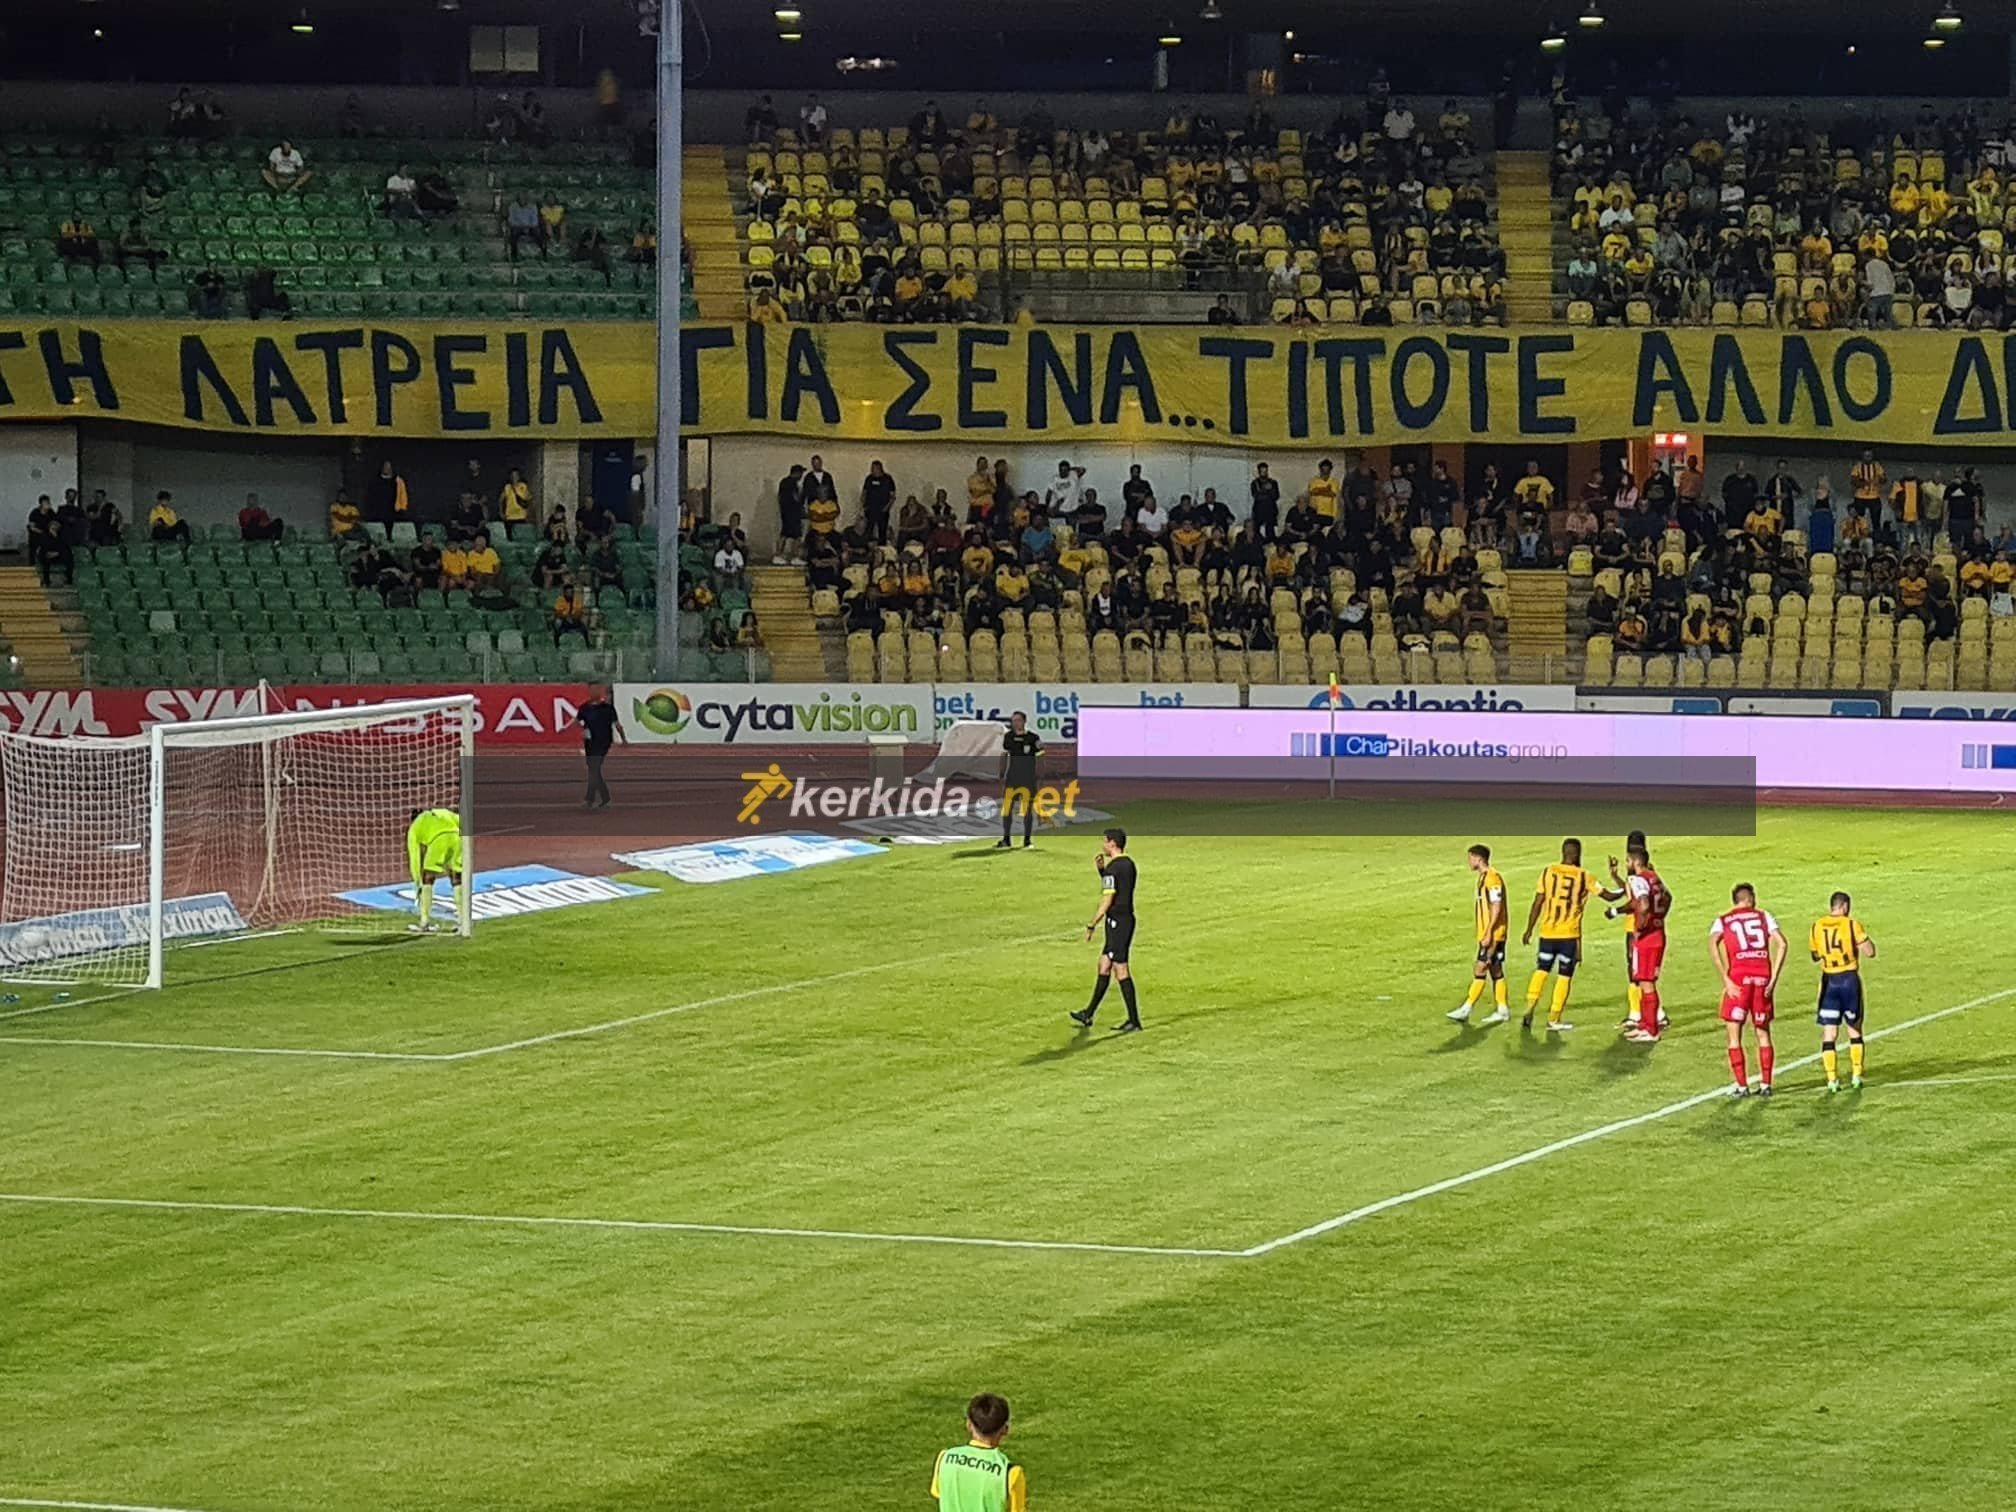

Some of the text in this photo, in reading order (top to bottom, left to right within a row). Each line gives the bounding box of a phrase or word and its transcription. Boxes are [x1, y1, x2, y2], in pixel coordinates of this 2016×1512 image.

[179, 328, 604, 431] ΛΑΤΡΕΙΑ
[1632, 330, 1892, 428] ΑΛΛΟ
[1036, 690, 1079, 714] bet
[696, 691, 918, 742] cytavision
[1037, 717, 1059, 730] on
[1551, 873, 1574, 900] 13
[1729, 919, 1766, 950] 15
[1823, 928, 1843, 955] 14
[945, 1453, 1002, 1476] macron
